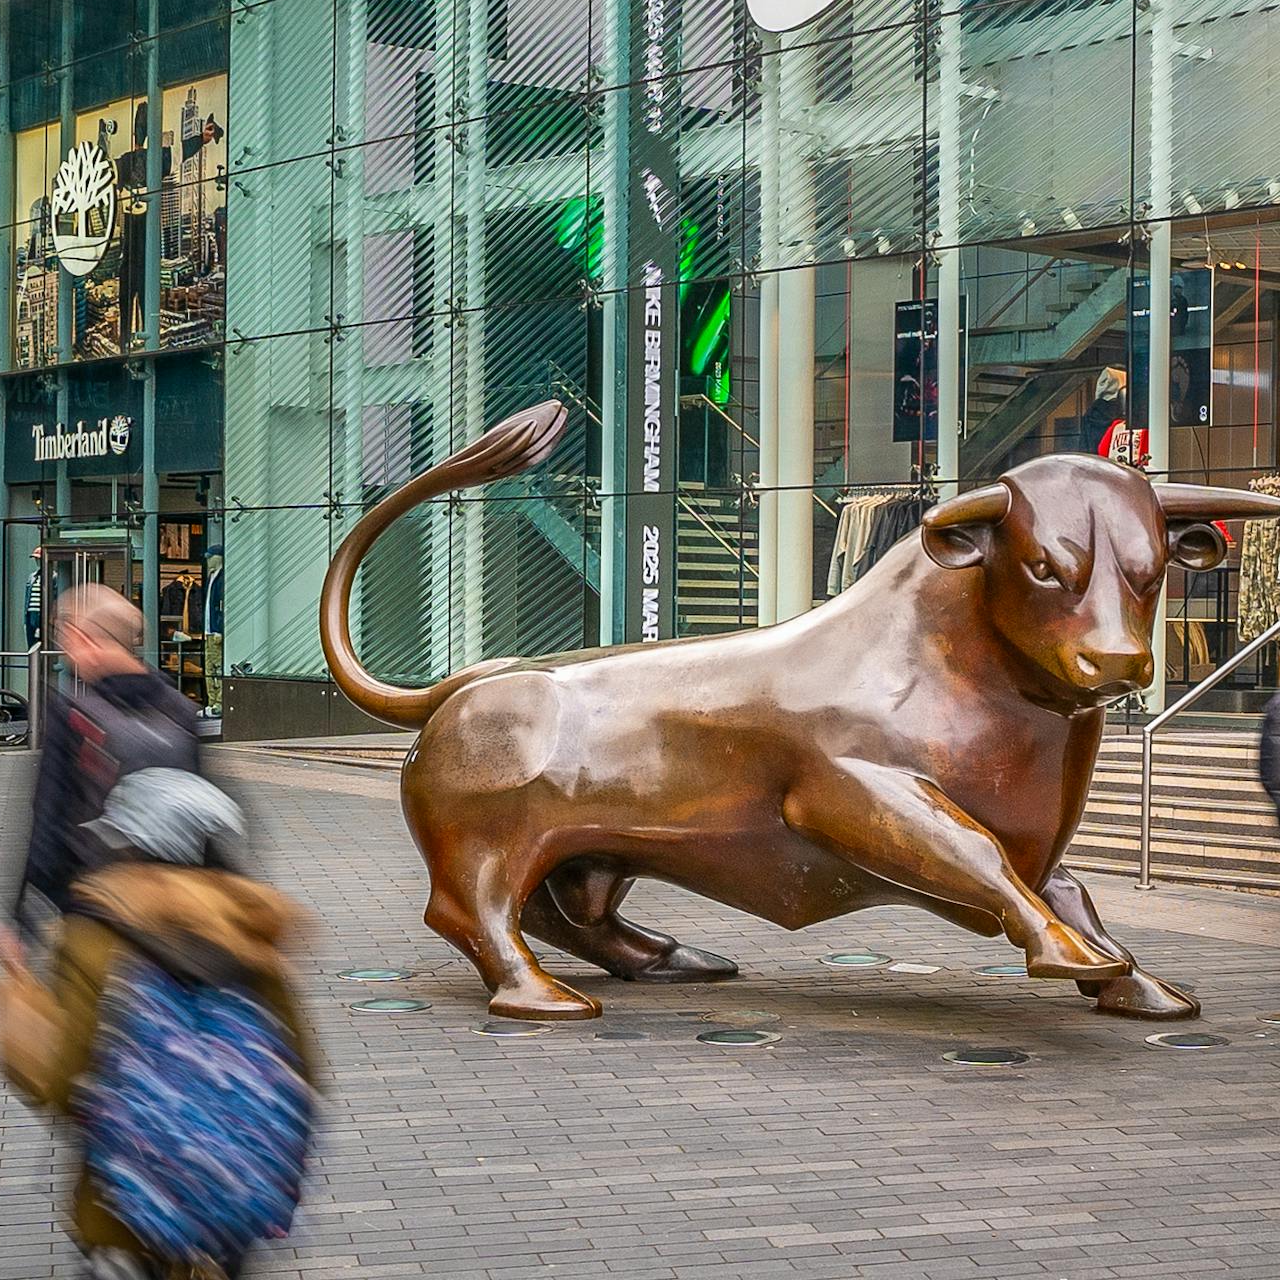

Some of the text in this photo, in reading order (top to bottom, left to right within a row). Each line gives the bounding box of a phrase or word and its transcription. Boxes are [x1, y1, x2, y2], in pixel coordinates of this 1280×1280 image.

[31, 417, 108, 462] Timberland
[643, 330, 661, 494] BIRMINGHAM
[642, 524, 660, 584] 2025
